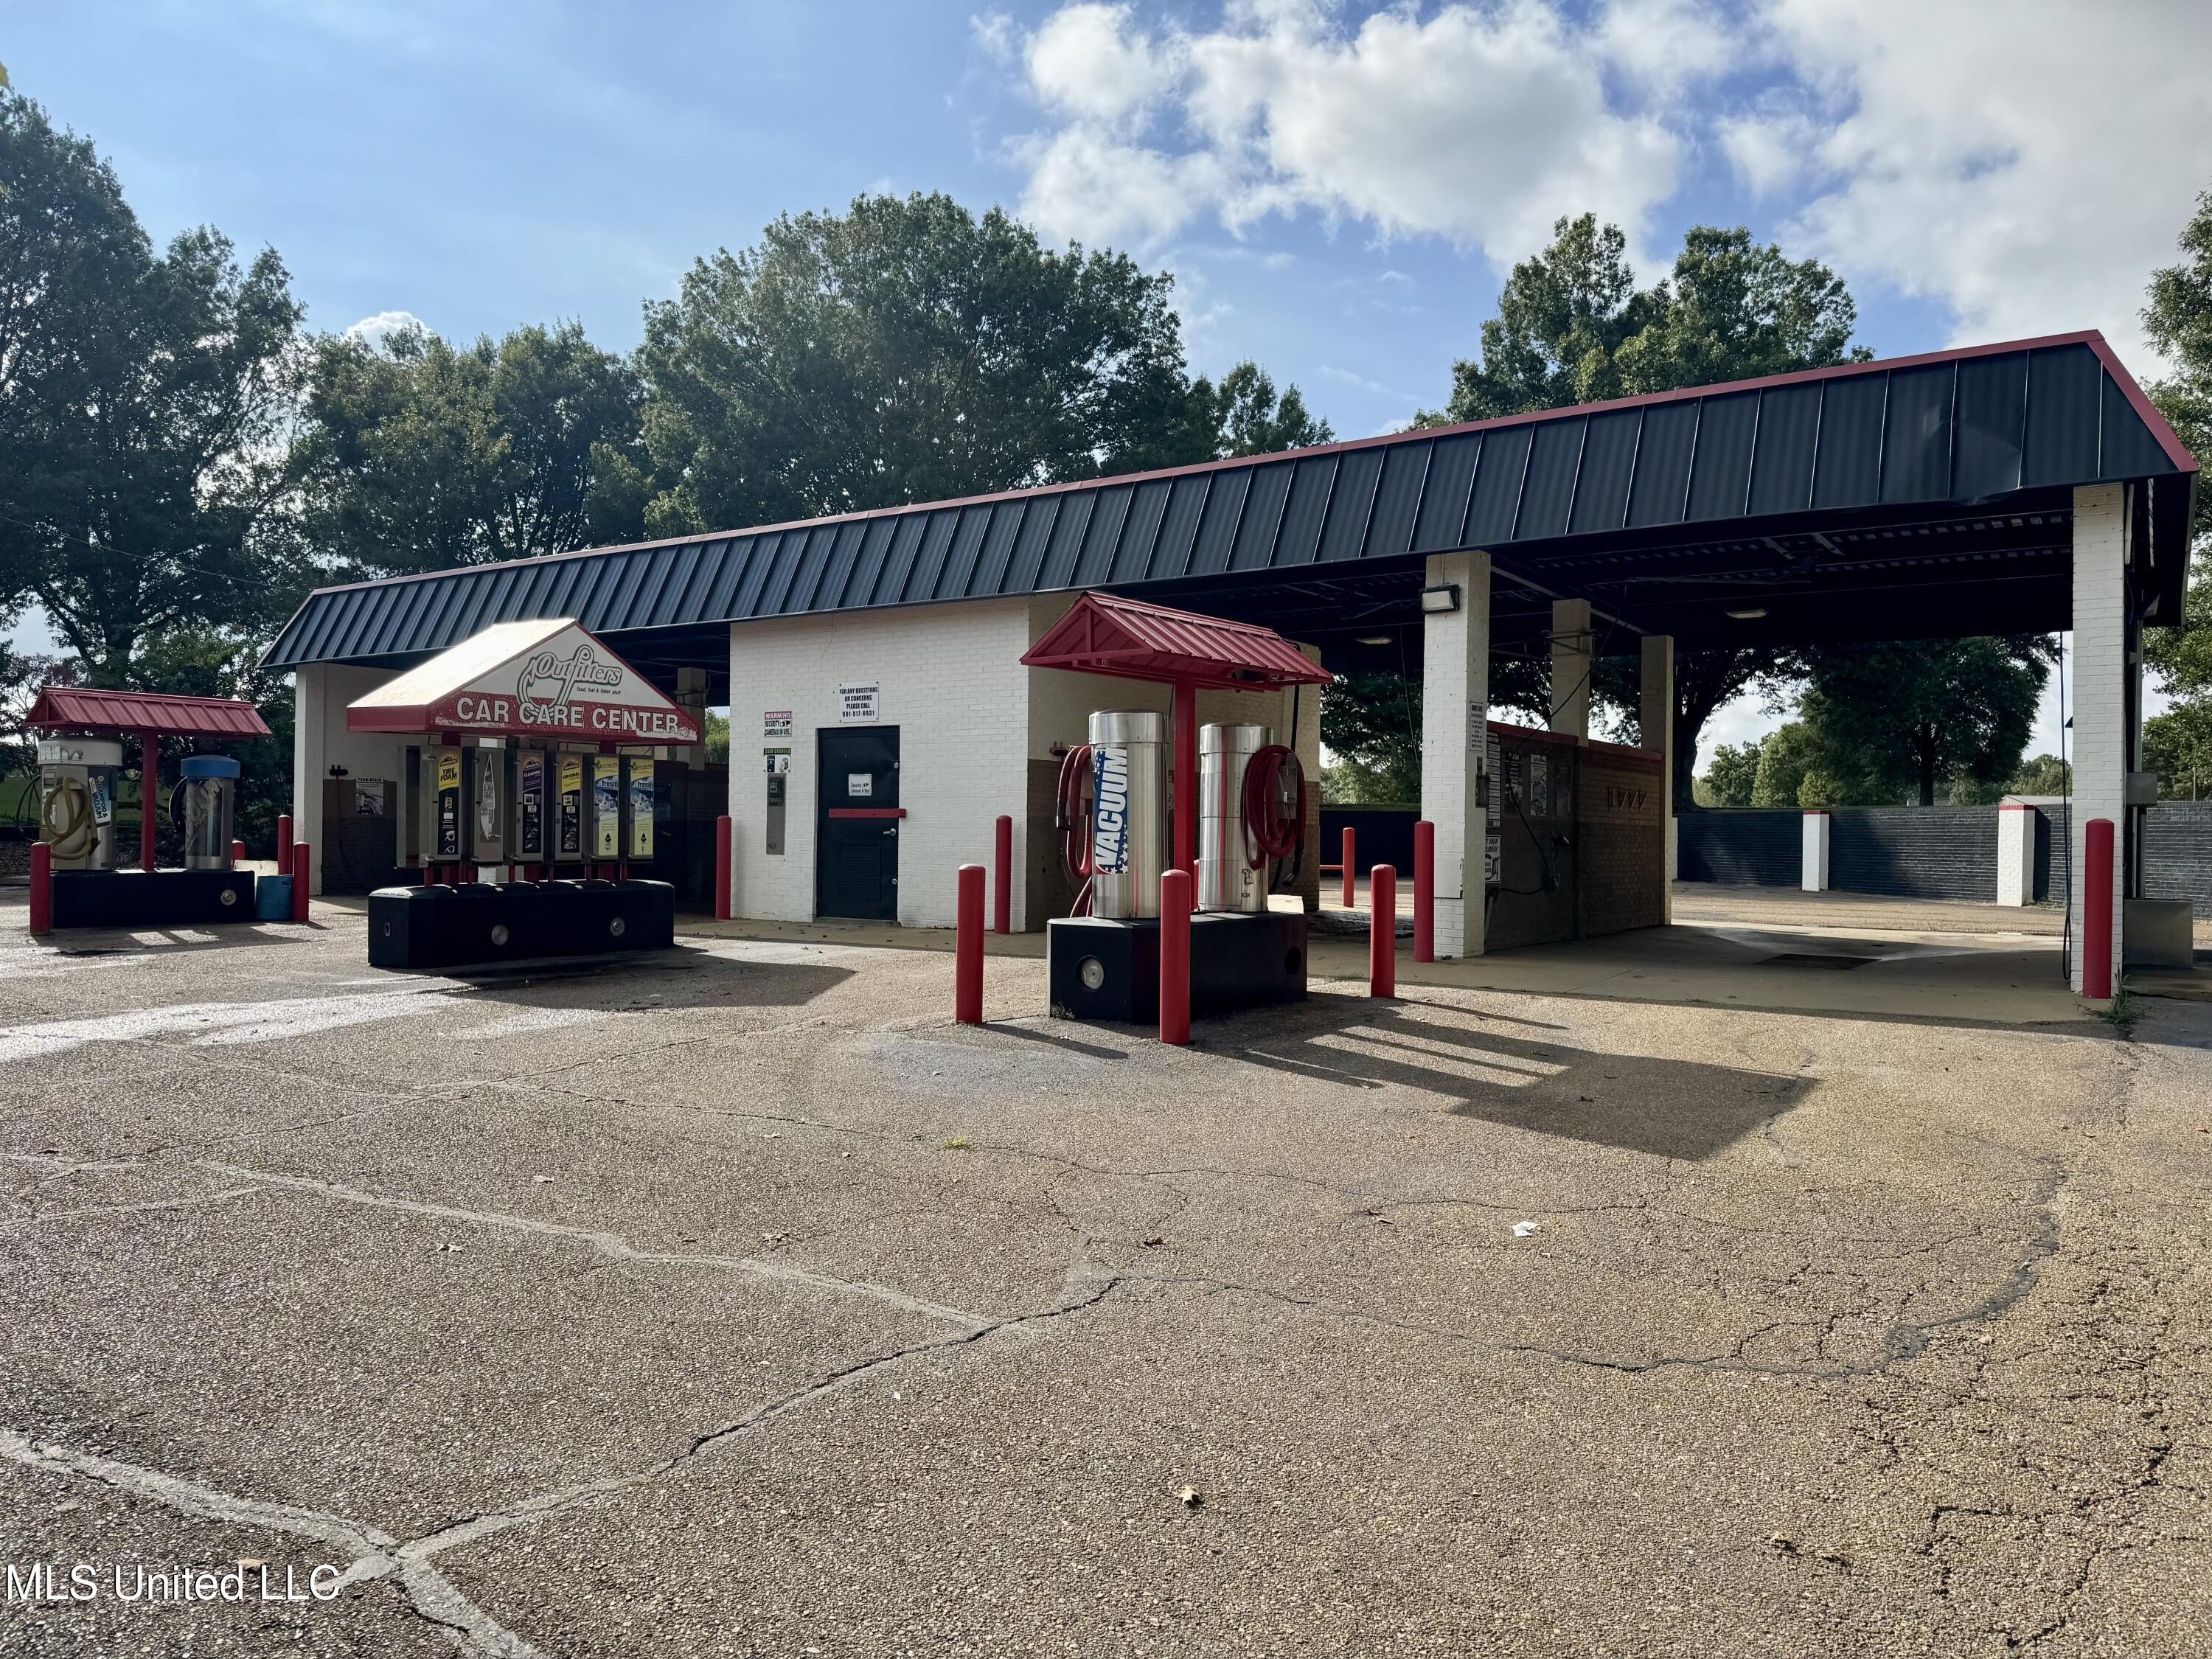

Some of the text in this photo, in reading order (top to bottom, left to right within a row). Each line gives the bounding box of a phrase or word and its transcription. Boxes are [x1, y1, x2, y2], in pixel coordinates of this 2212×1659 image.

[532, 644, 622, 686] Outfitters
[456, 697, 679, 734] CAR CARE CENTER
[440, 772, 457, 782] FOAM
[442, 767, 455, 775] TIRE
[92, 792, 102, 818] VACUUM
[1096, 748, 1127, 866] VACUUM
